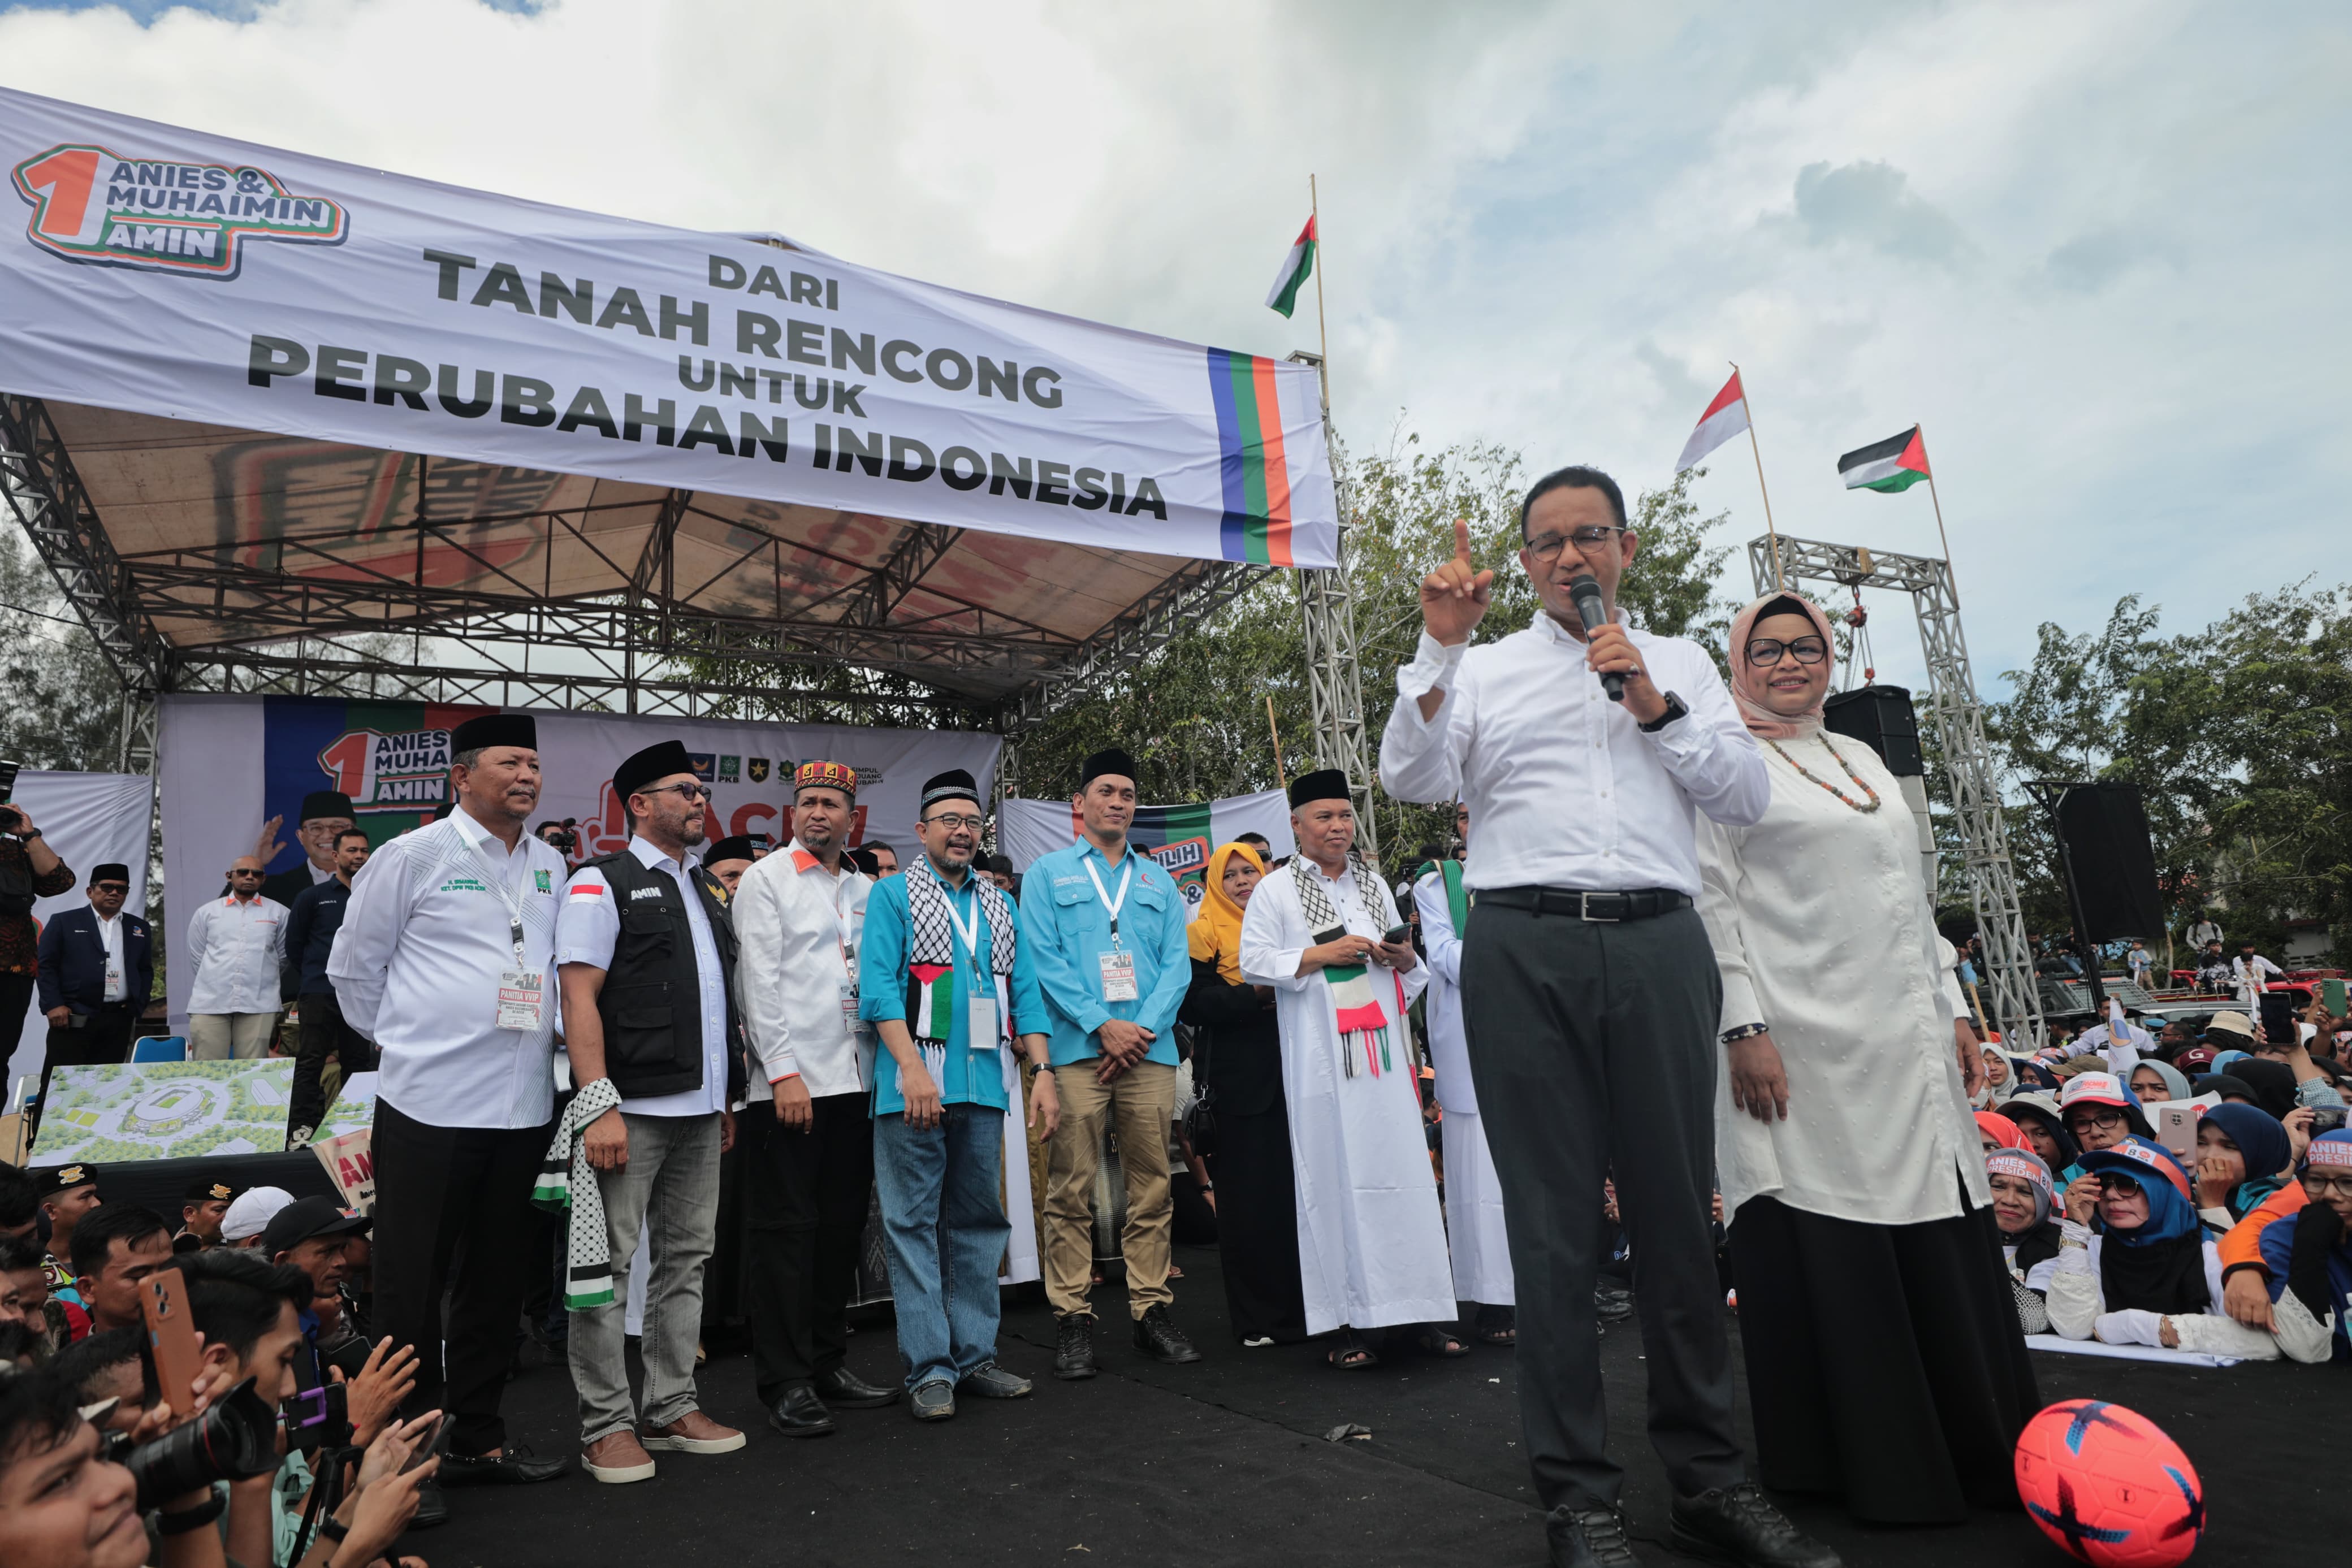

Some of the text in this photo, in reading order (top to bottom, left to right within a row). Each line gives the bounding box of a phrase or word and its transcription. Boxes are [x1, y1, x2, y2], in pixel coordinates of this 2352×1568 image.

[24, 150, 101, 236] 1
[109, 162, 265, 194] ANIES &
[106, 185, 323, 222] MUHAIMIN
[105, 224, 218, 258] AMIN
[709, 254, 838, 311] DARI
[423, 248, 1063, 410] TANAH RENCONG
[678, 354, 868, 418] UNTUK
[248, 333, 1168, 521] PERUBAHAN INDONESIA
[375, 731, 448, 753] ANIES
[325, 733, 368, 798] 1
[377, 779, 444, 801] AMIN
[631, 887, 662, 900] AMIN
[1187, 885, 1201, 905] &
[500, 990, 539, 1001] PANITIA VVIP
[2189, 1049, 2204, 1059] G
[1988, 1157, 2027, 1169] ANIES
